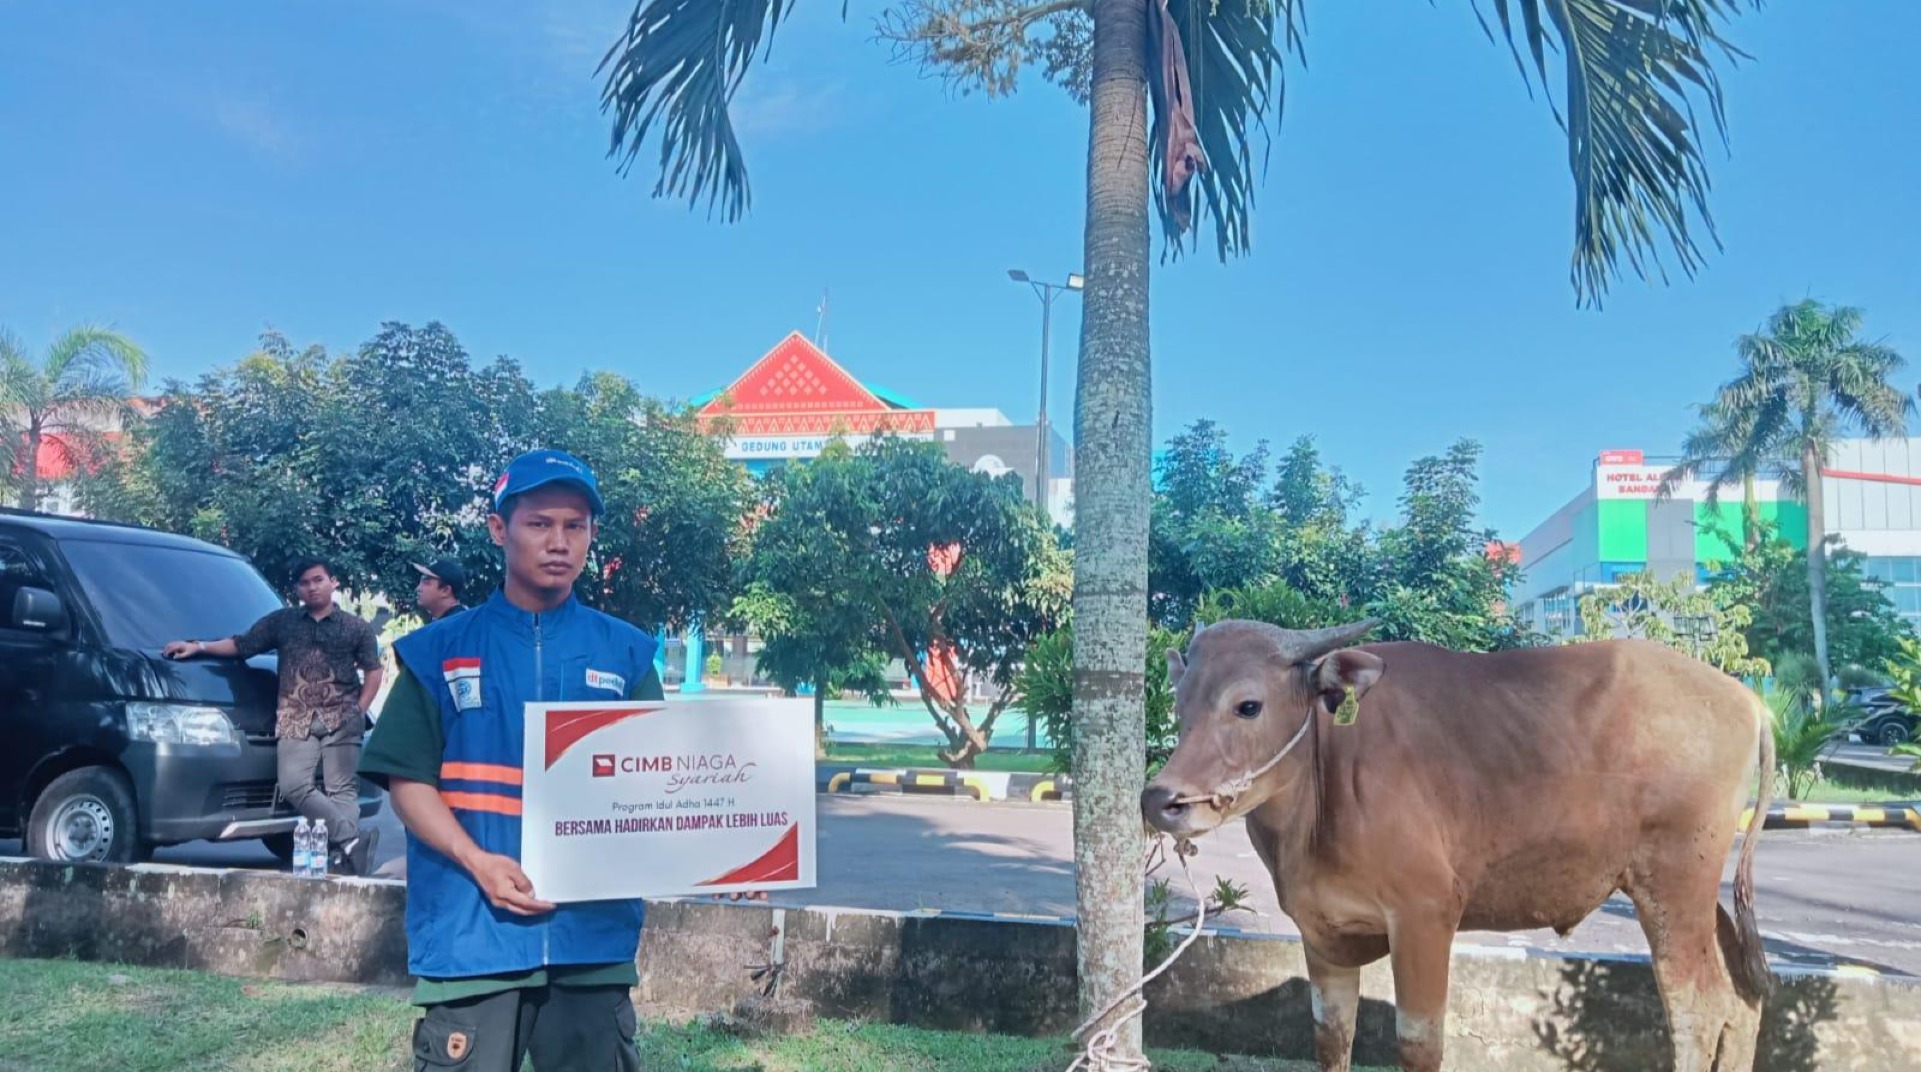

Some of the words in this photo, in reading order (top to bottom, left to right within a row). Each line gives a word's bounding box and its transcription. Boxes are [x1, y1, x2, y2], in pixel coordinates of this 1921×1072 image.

[742, 440, 787, 452] GEDUNG
[792, 440, 822, 451] UTAM
[1607, 473, 1642, 482] HOTEL
[621, 756, 672, 773] CIMB
[676, 754, 737, 772] NIAGA
[664, 762, 757, 794] Syariah
[612, 801, 653, 814] Program
[656, 801, 673, 810] Idul
[675, 799, 701, 809] Adha
[703, 798, 725, 808] 1447
[555, 819, 612, 837] BERSAMA
[614, 816, 673, 834] HADIRKAN
[676, 814, 723, 831] DAMPAK
[726, 812, 758, 829] LEBIH
[760, 811, 789, 827] LUAS
